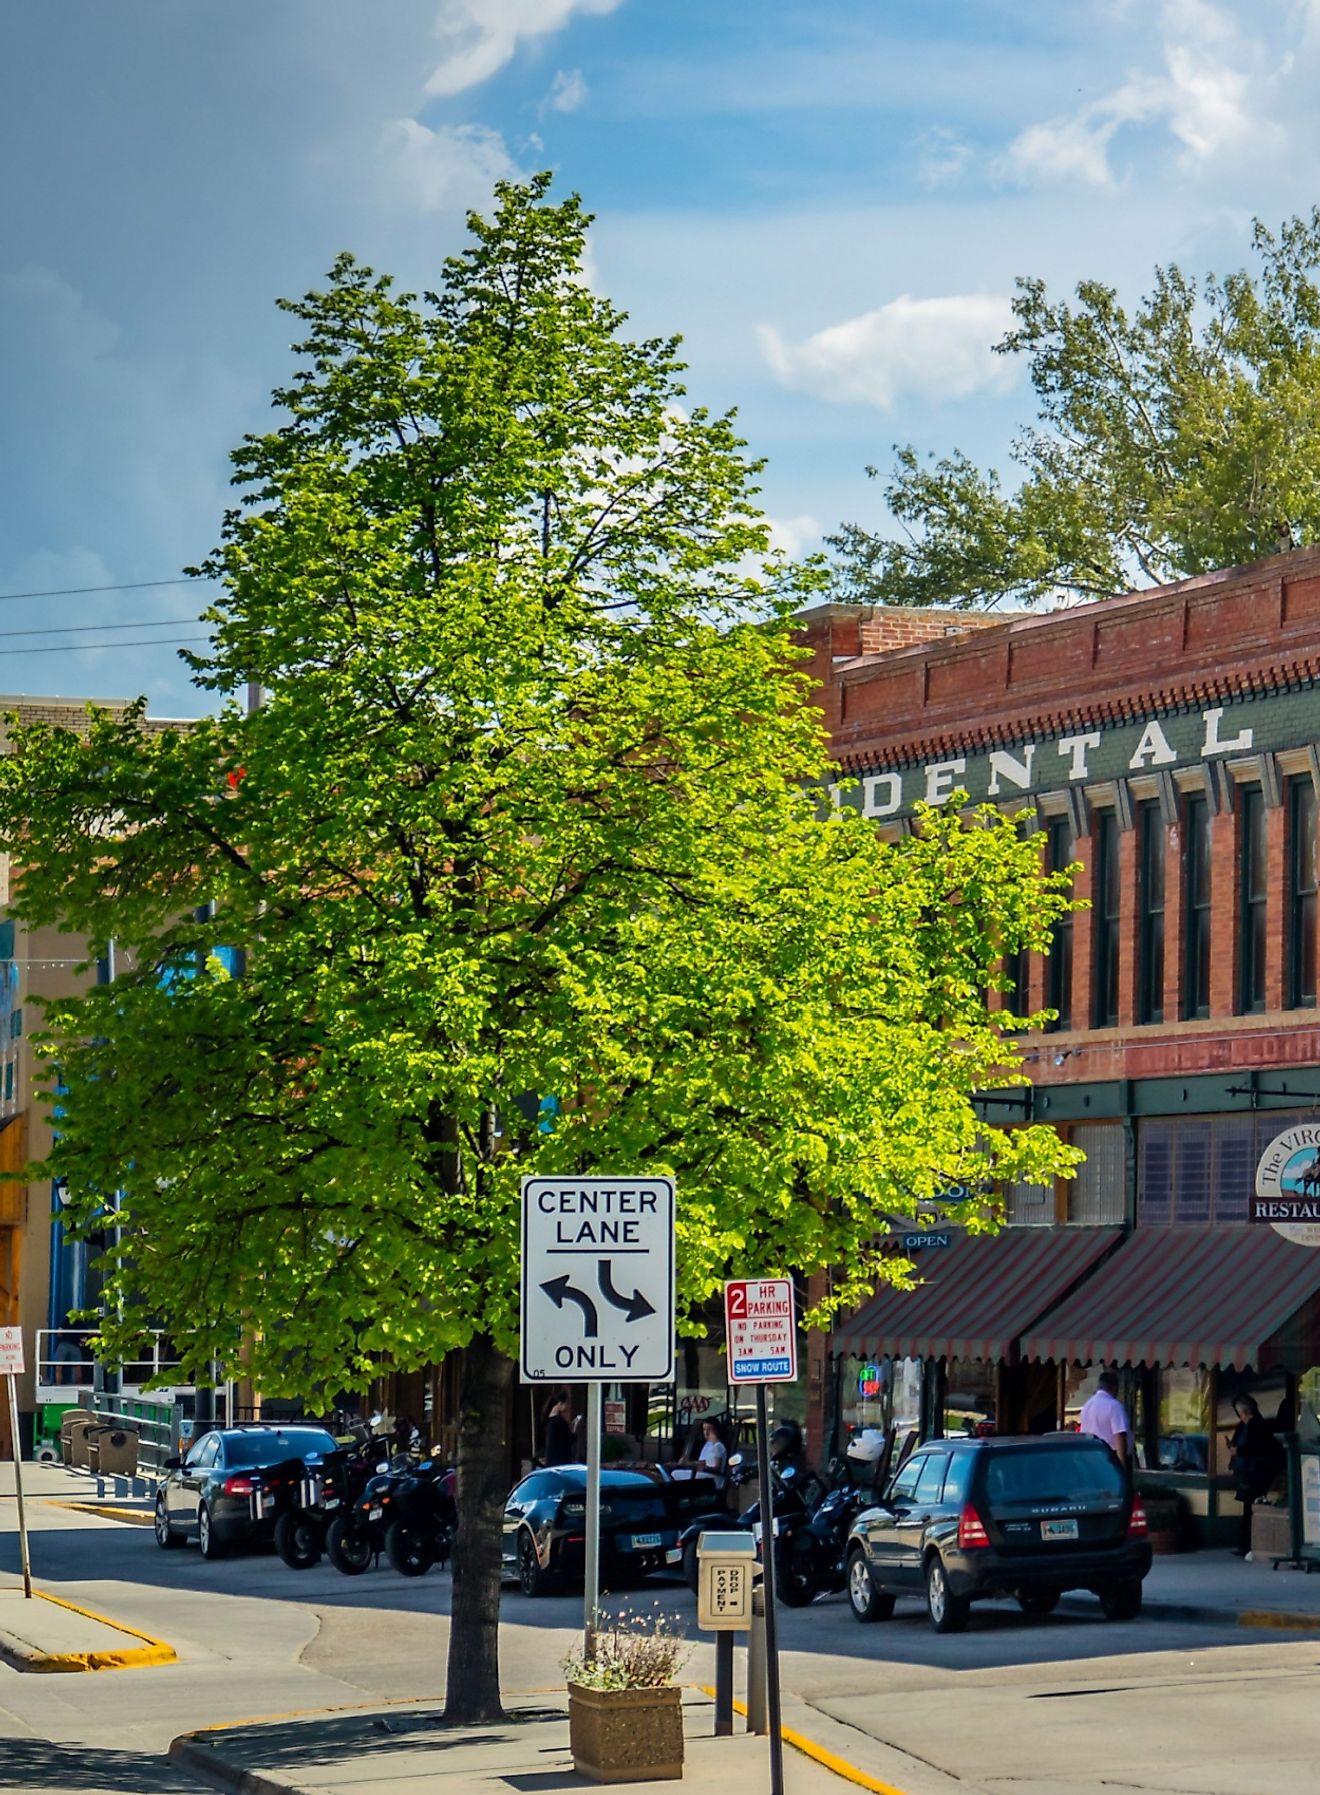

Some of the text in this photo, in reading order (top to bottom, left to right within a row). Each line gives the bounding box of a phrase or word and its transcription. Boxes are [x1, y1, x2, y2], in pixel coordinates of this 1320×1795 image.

[790, 707, 1253, 824] IDENTAL
[1262, 1153, 1284, 1185] The
[538, 1191, 657, 1213] CENTER
[557, 1221, 639, 1243] LANE
[906, 1235, 948, 1246] OPEN
[731, 1286, 775, 1314] 2 HR
[748, 1301, 788, 1315] PARKING
[738, 1321, 783, 1330] NO PARKING
[750, 1334, 787, 1343] THURSDAY
[555, 1345, 639, 1368] ONLY
[735, 1361, 789, 1373] SNOW ROUTE
[717, 1570, 726, 1612] PAYMENT
[730, 1570, 739, 1594] DROP
